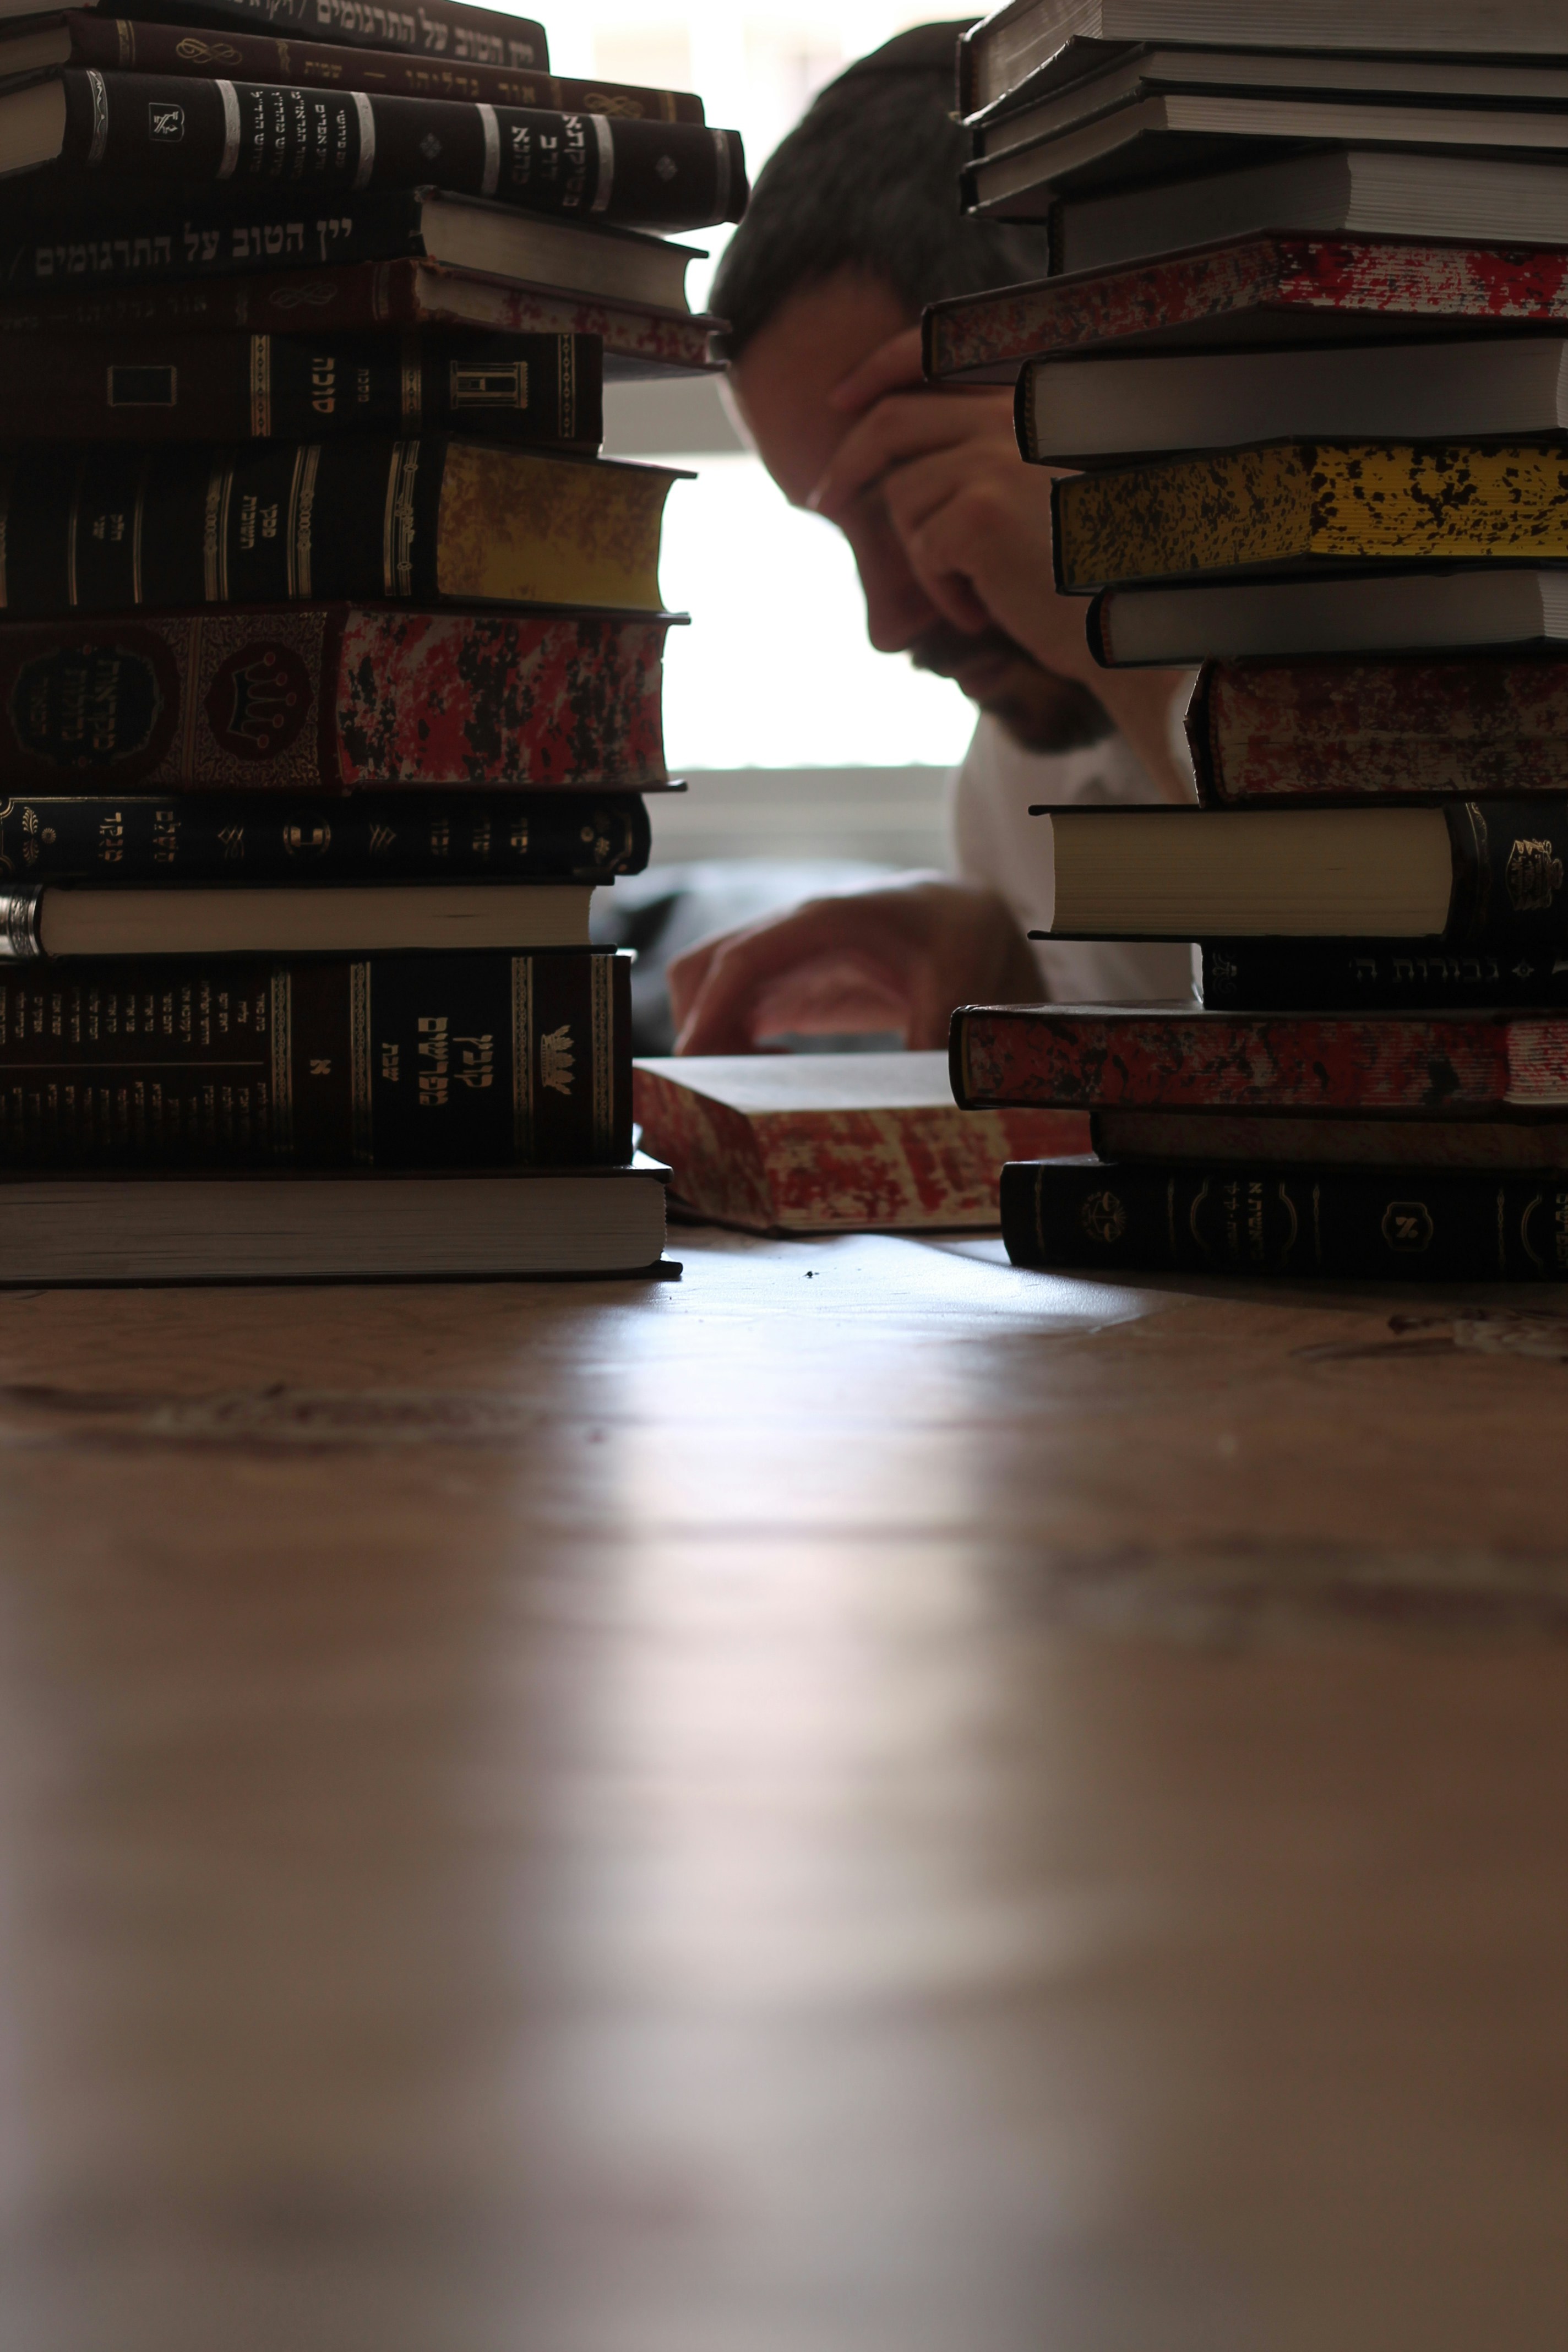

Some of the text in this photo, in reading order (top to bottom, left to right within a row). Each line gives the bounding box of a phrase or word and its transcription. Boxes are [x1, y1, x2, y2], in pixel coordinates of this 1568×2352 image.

[315, 2, 416, 44] התרגומים
[416, 7, 448, 51] על
[454, 28, 504, 64] הטוב
[508, 41, 533, 68] יין
[405, 68, 479, 97] גדליהו
[314, 104, 327, 144] אפרים
[336, 110, 347, 149] פירושי
[511, 126, 532, 186] כהנא
[539, 134, 559, 180] דרב
[562, 114, 586, 207] פסיקתא
[35, 217, 352, 276] יין הטוב על התרגומים
[311, 357, 335, 413] סוכה
[357, 368, 369, 402] מסכת
[239, 495, 257, 549] תשובות
[61, 667, 95, 742] גדולות
[88, 658, 120, 750] מקראות
[1392, 956, 1500, 983] גבורות
[309, 1059, 332, 1075] א
[382, 1042, 400, 1082] שבת
[417, 1016, 449, 1106] מפרשים
[452, 1034, 494, 1088] קובץ
[1248, 1182, 1265, 1260] בראשית א
[1394, 1216, 1419, 1239] א
